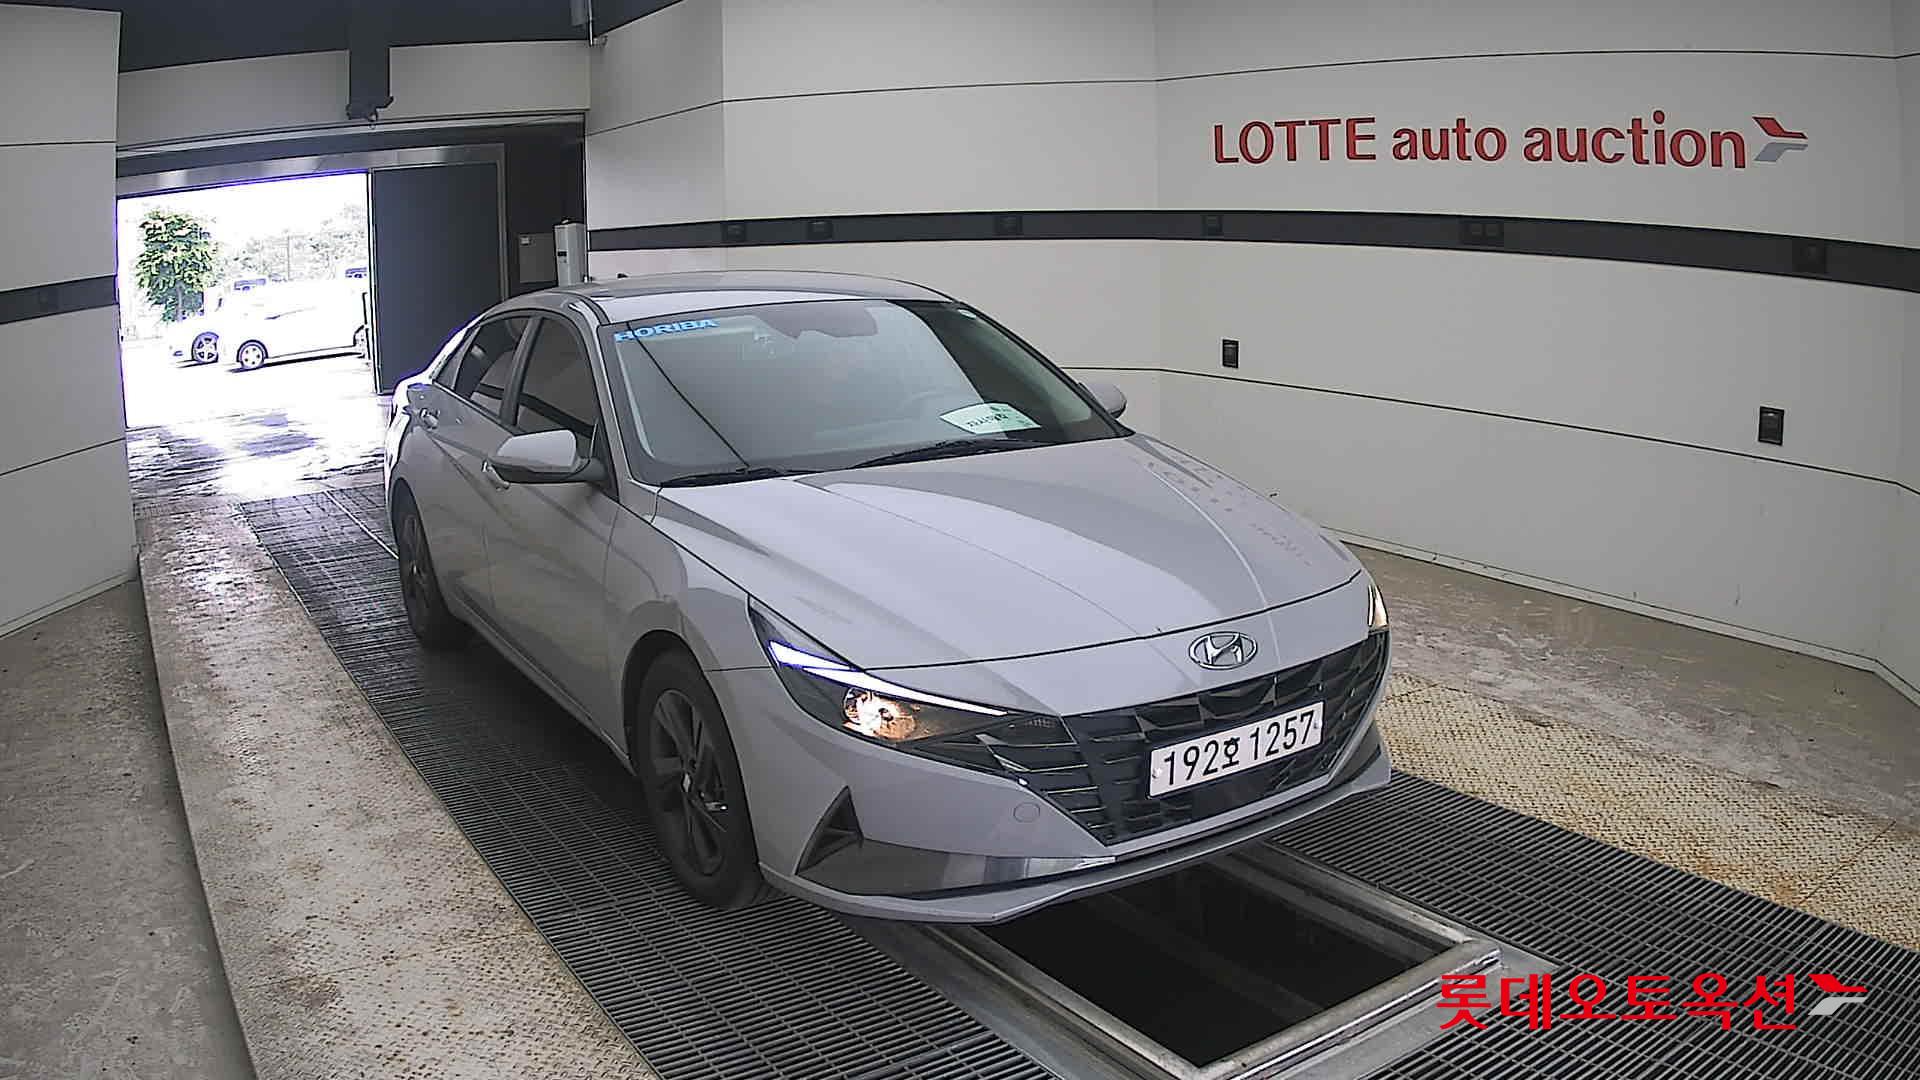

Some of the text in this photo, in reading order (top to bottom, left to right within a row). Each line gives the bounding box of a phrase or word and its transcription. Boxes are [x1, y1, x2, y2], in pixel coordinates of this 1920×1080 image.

[1213, 109, 1747, 169] LOTTE auto auction
[1249, 710, 1314, 761] 1257
